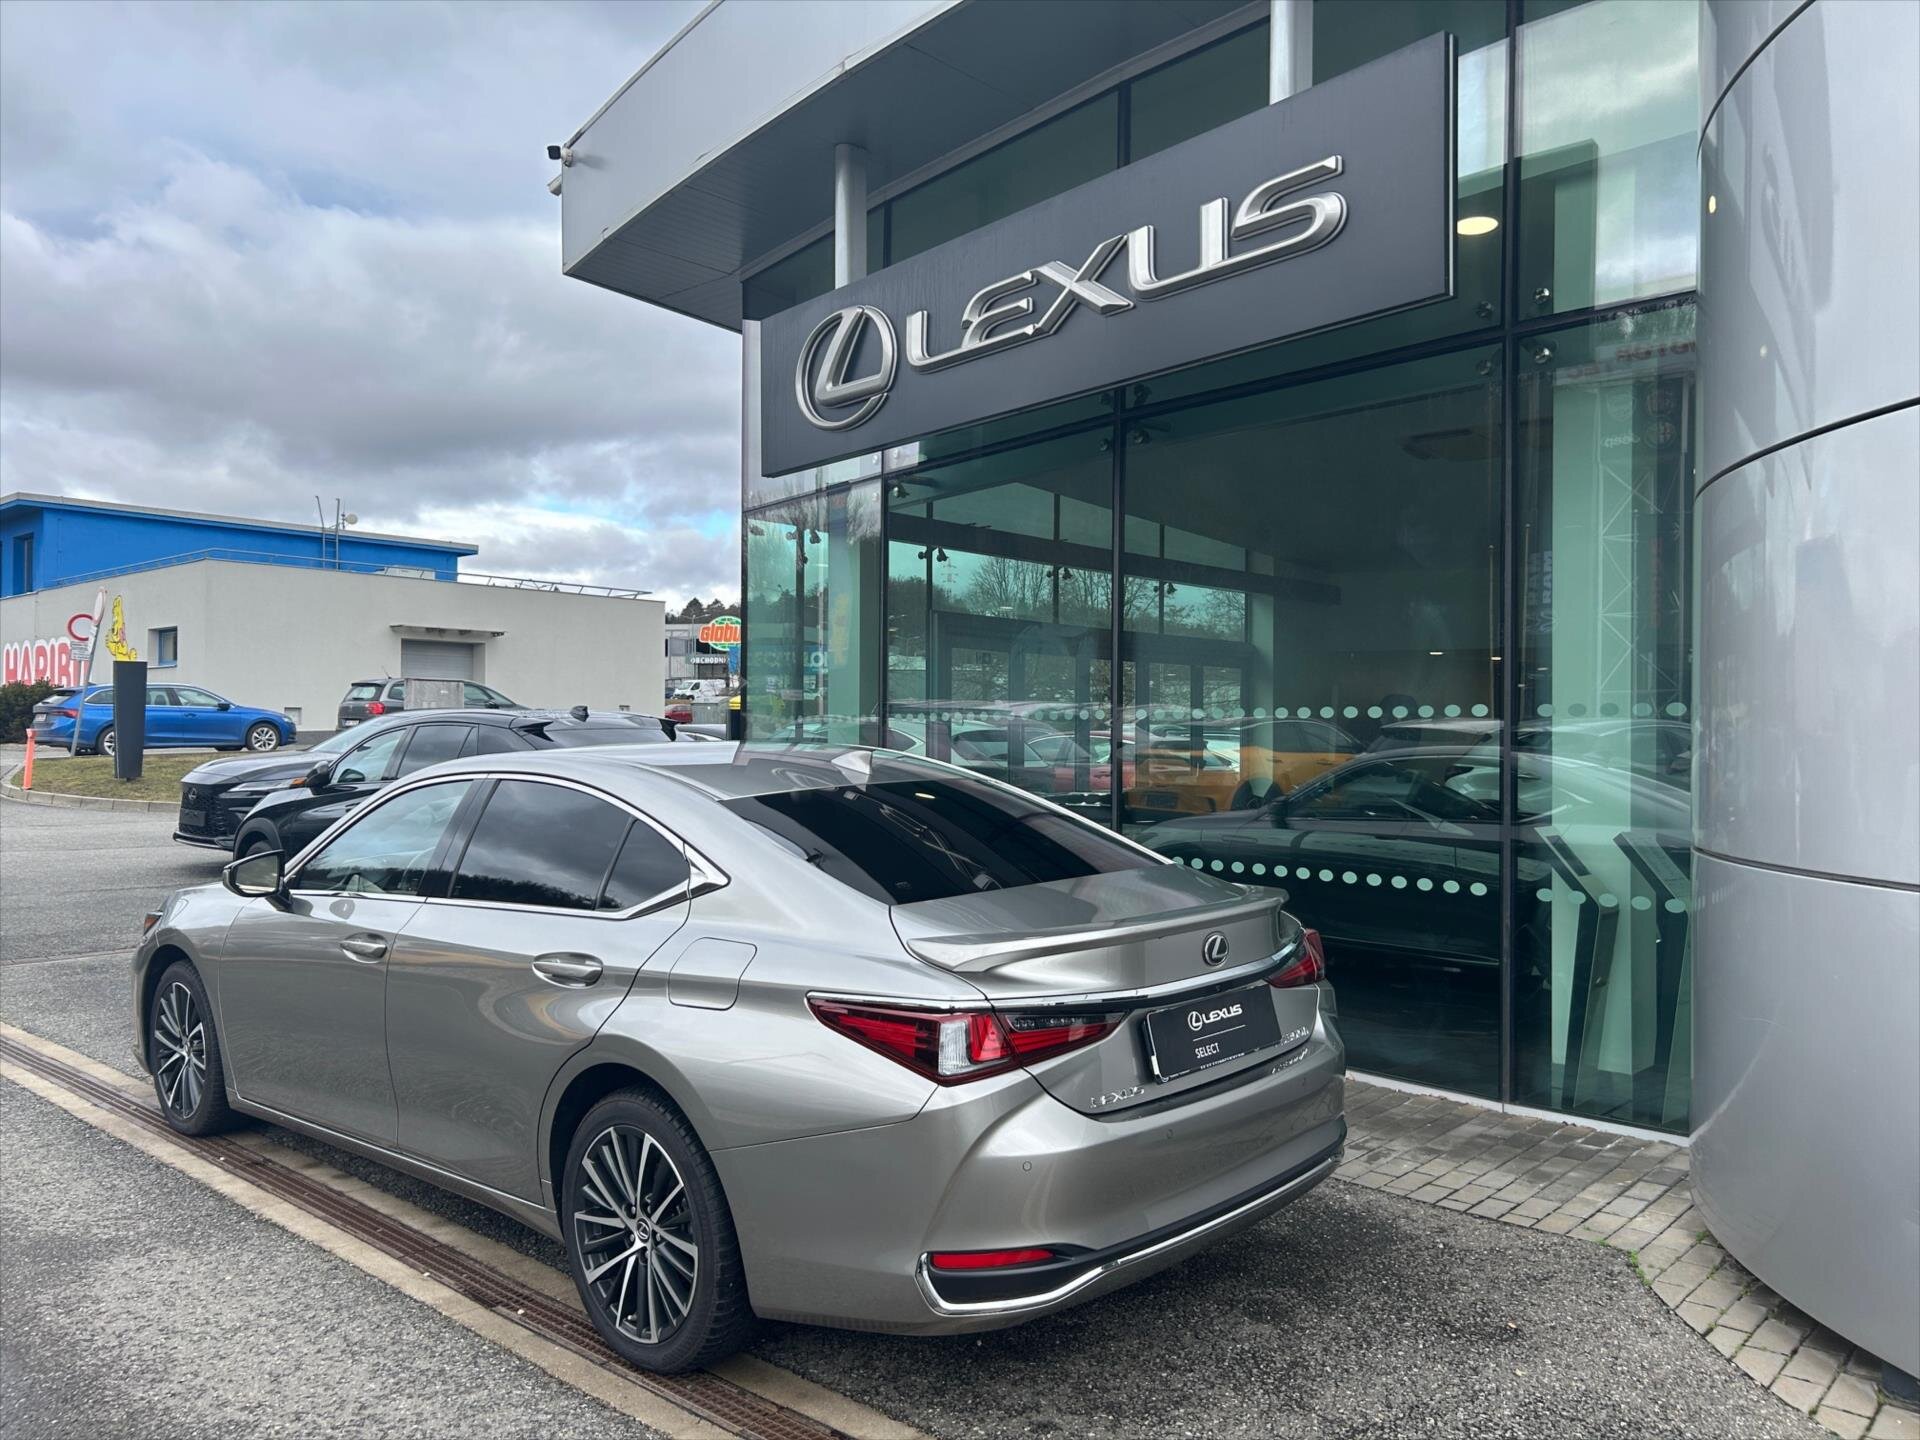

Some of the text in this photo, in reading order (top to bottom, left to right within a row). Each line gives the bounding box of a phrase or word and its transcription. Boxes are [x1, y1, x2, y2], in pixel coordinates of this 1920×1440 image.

[906, 154, 1349, 374] LEXUS
[1201, 1003, 1243, 1024] LEXUS
[1194, 1042, 1220, 1059] SELECT
